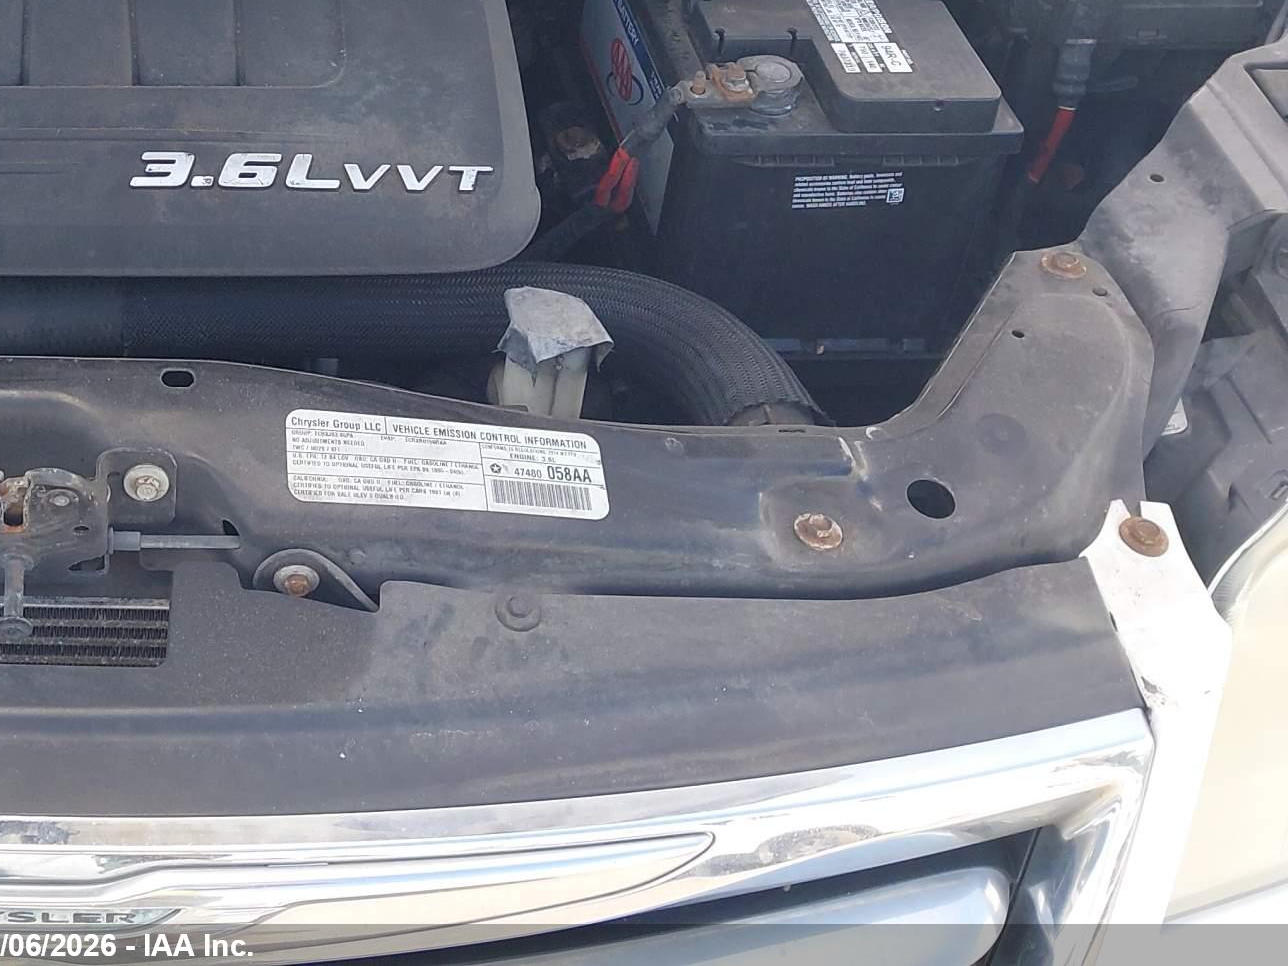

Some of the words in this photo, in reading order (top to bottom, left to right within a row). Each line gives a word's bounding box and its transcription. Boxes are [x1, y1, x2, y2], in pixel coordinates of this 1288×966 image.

[617, 0, 640, 46] BATTERY
[291, 417, 330, 429] Chrysler
[333, 419, 361, 432] Group
[364, 422, 382, 432] LLC
[392, 424, 430, 435] VEHICLE
[433, 427, 477, 439] EMISSION
[480, 432, 521, 444] CONTROL
[524, 436, 587, 450] INFORMATION
[547, 465, 592, 483] 058AA
